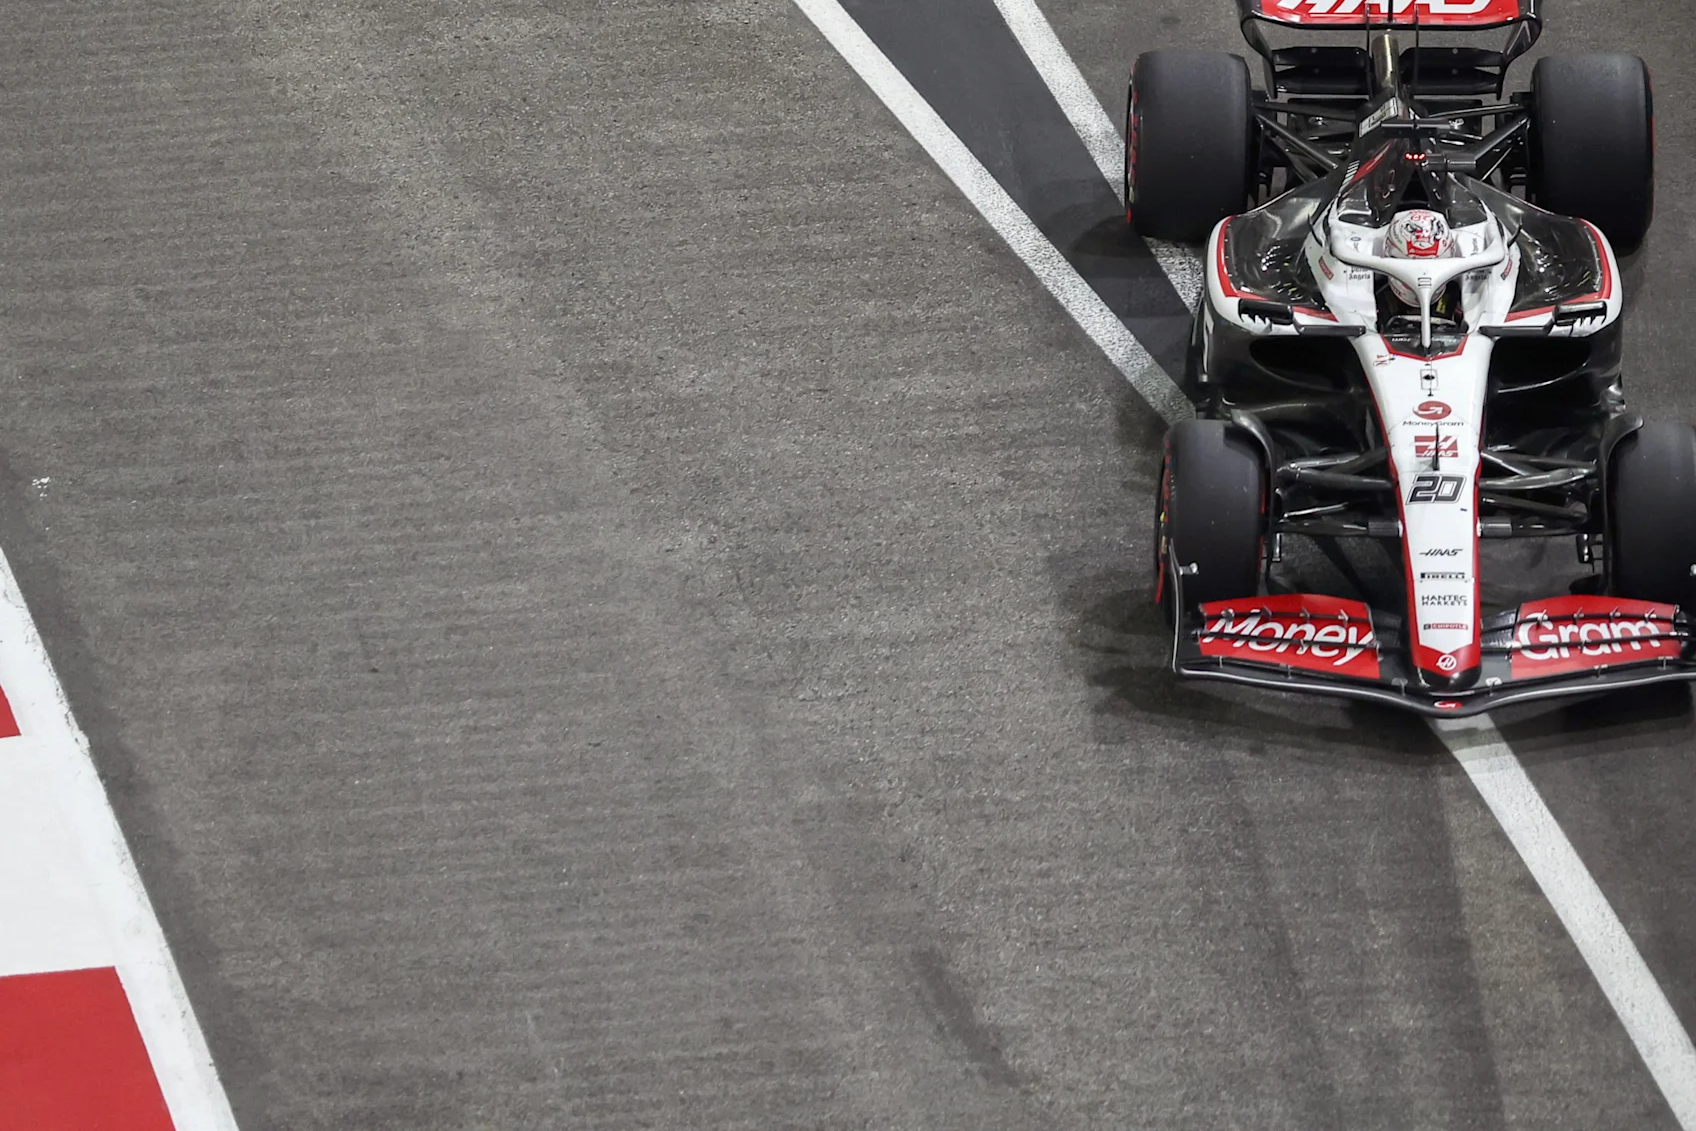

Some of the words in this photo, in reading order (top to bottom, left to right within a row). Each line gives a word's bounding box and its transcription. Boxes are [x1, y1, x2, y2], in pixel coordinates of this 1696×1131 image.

[1405, 473, 1468, 505] 20
[1419, 548, 1464, 557] HAAS
[1203, 608, 1376, 667] Money
[1518, 611, 1662, 661] Gram
